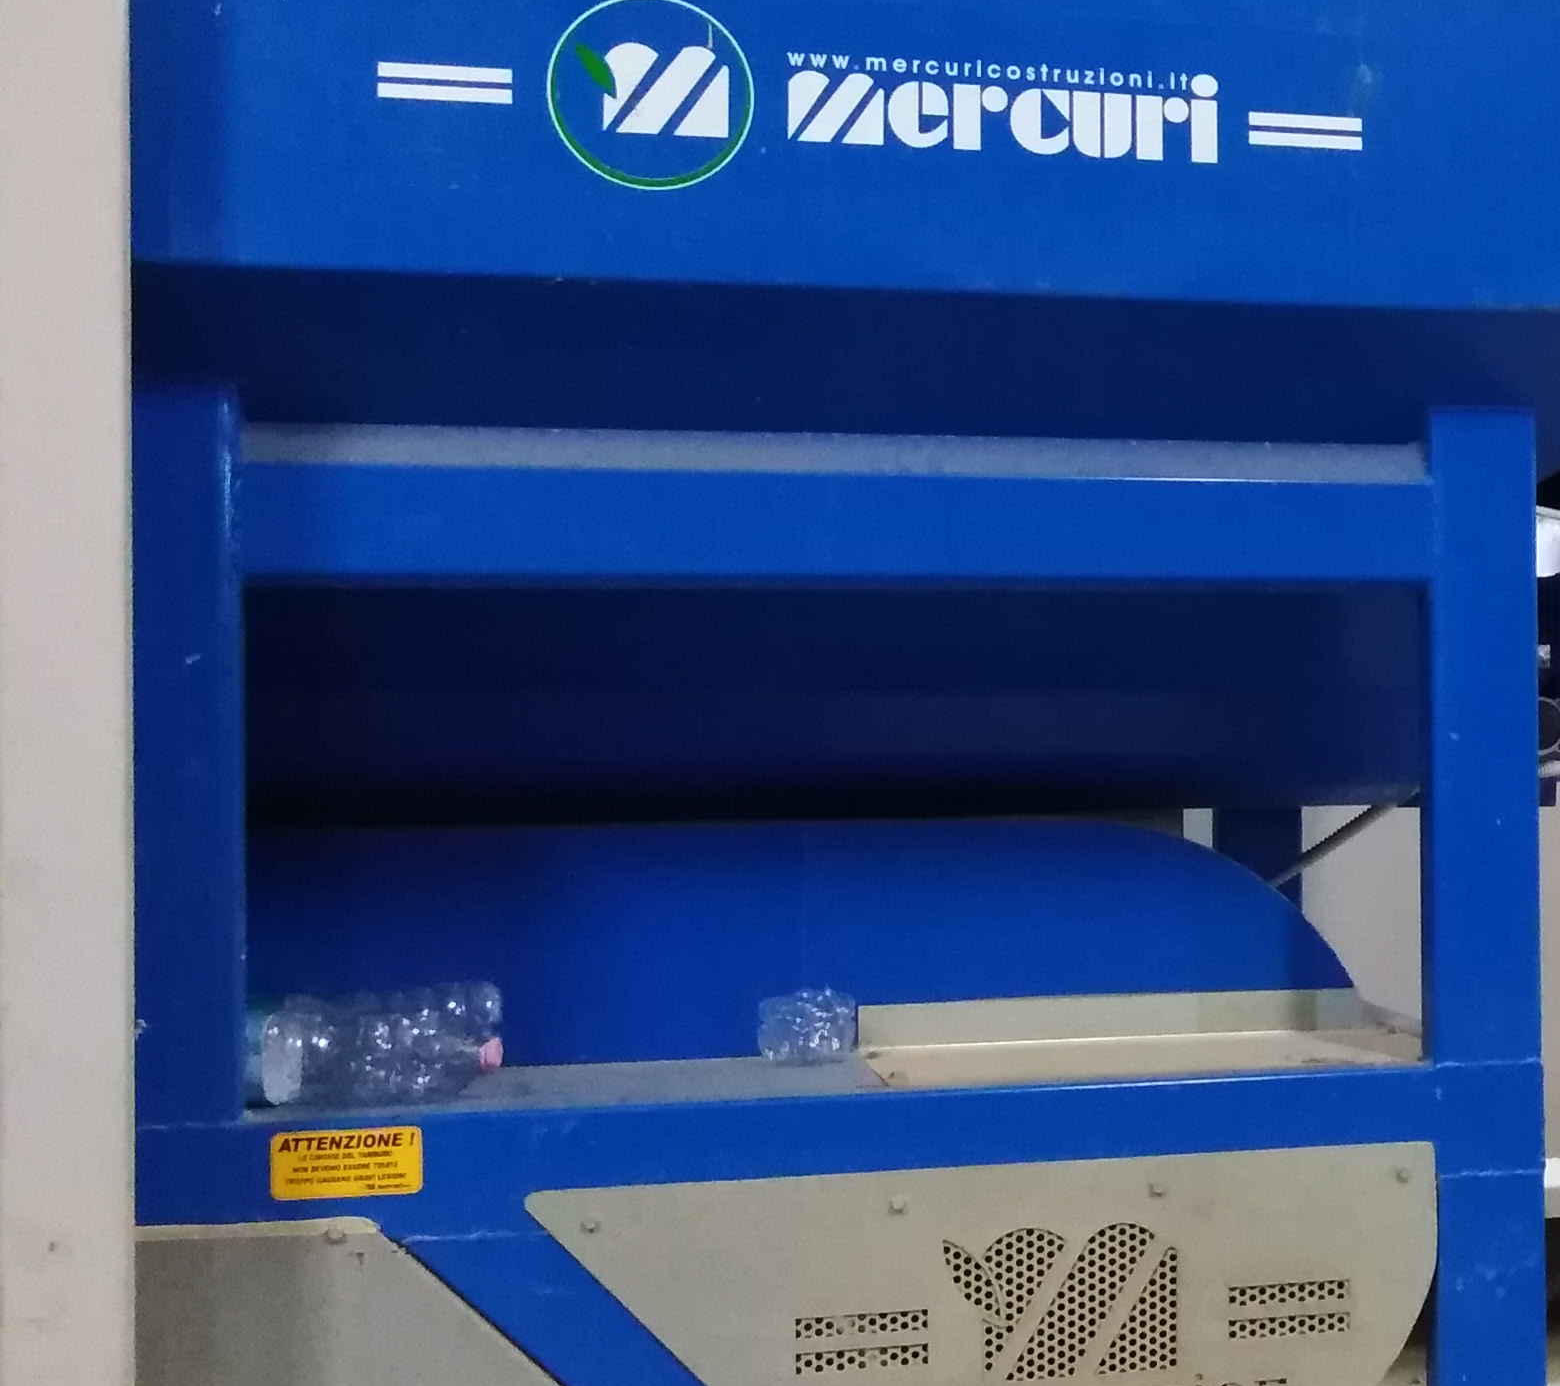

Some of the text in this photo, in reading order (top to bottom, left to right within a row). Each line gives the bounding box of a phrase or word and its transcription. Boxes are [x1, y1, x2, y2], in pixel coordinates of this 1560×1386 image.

[787, 51, 1189, 91] www.mercuricostruzioni.it
[787, 69, 1219, 163] Mercuri
[278, 1132, 416, 1153] ATTENZIONE !
